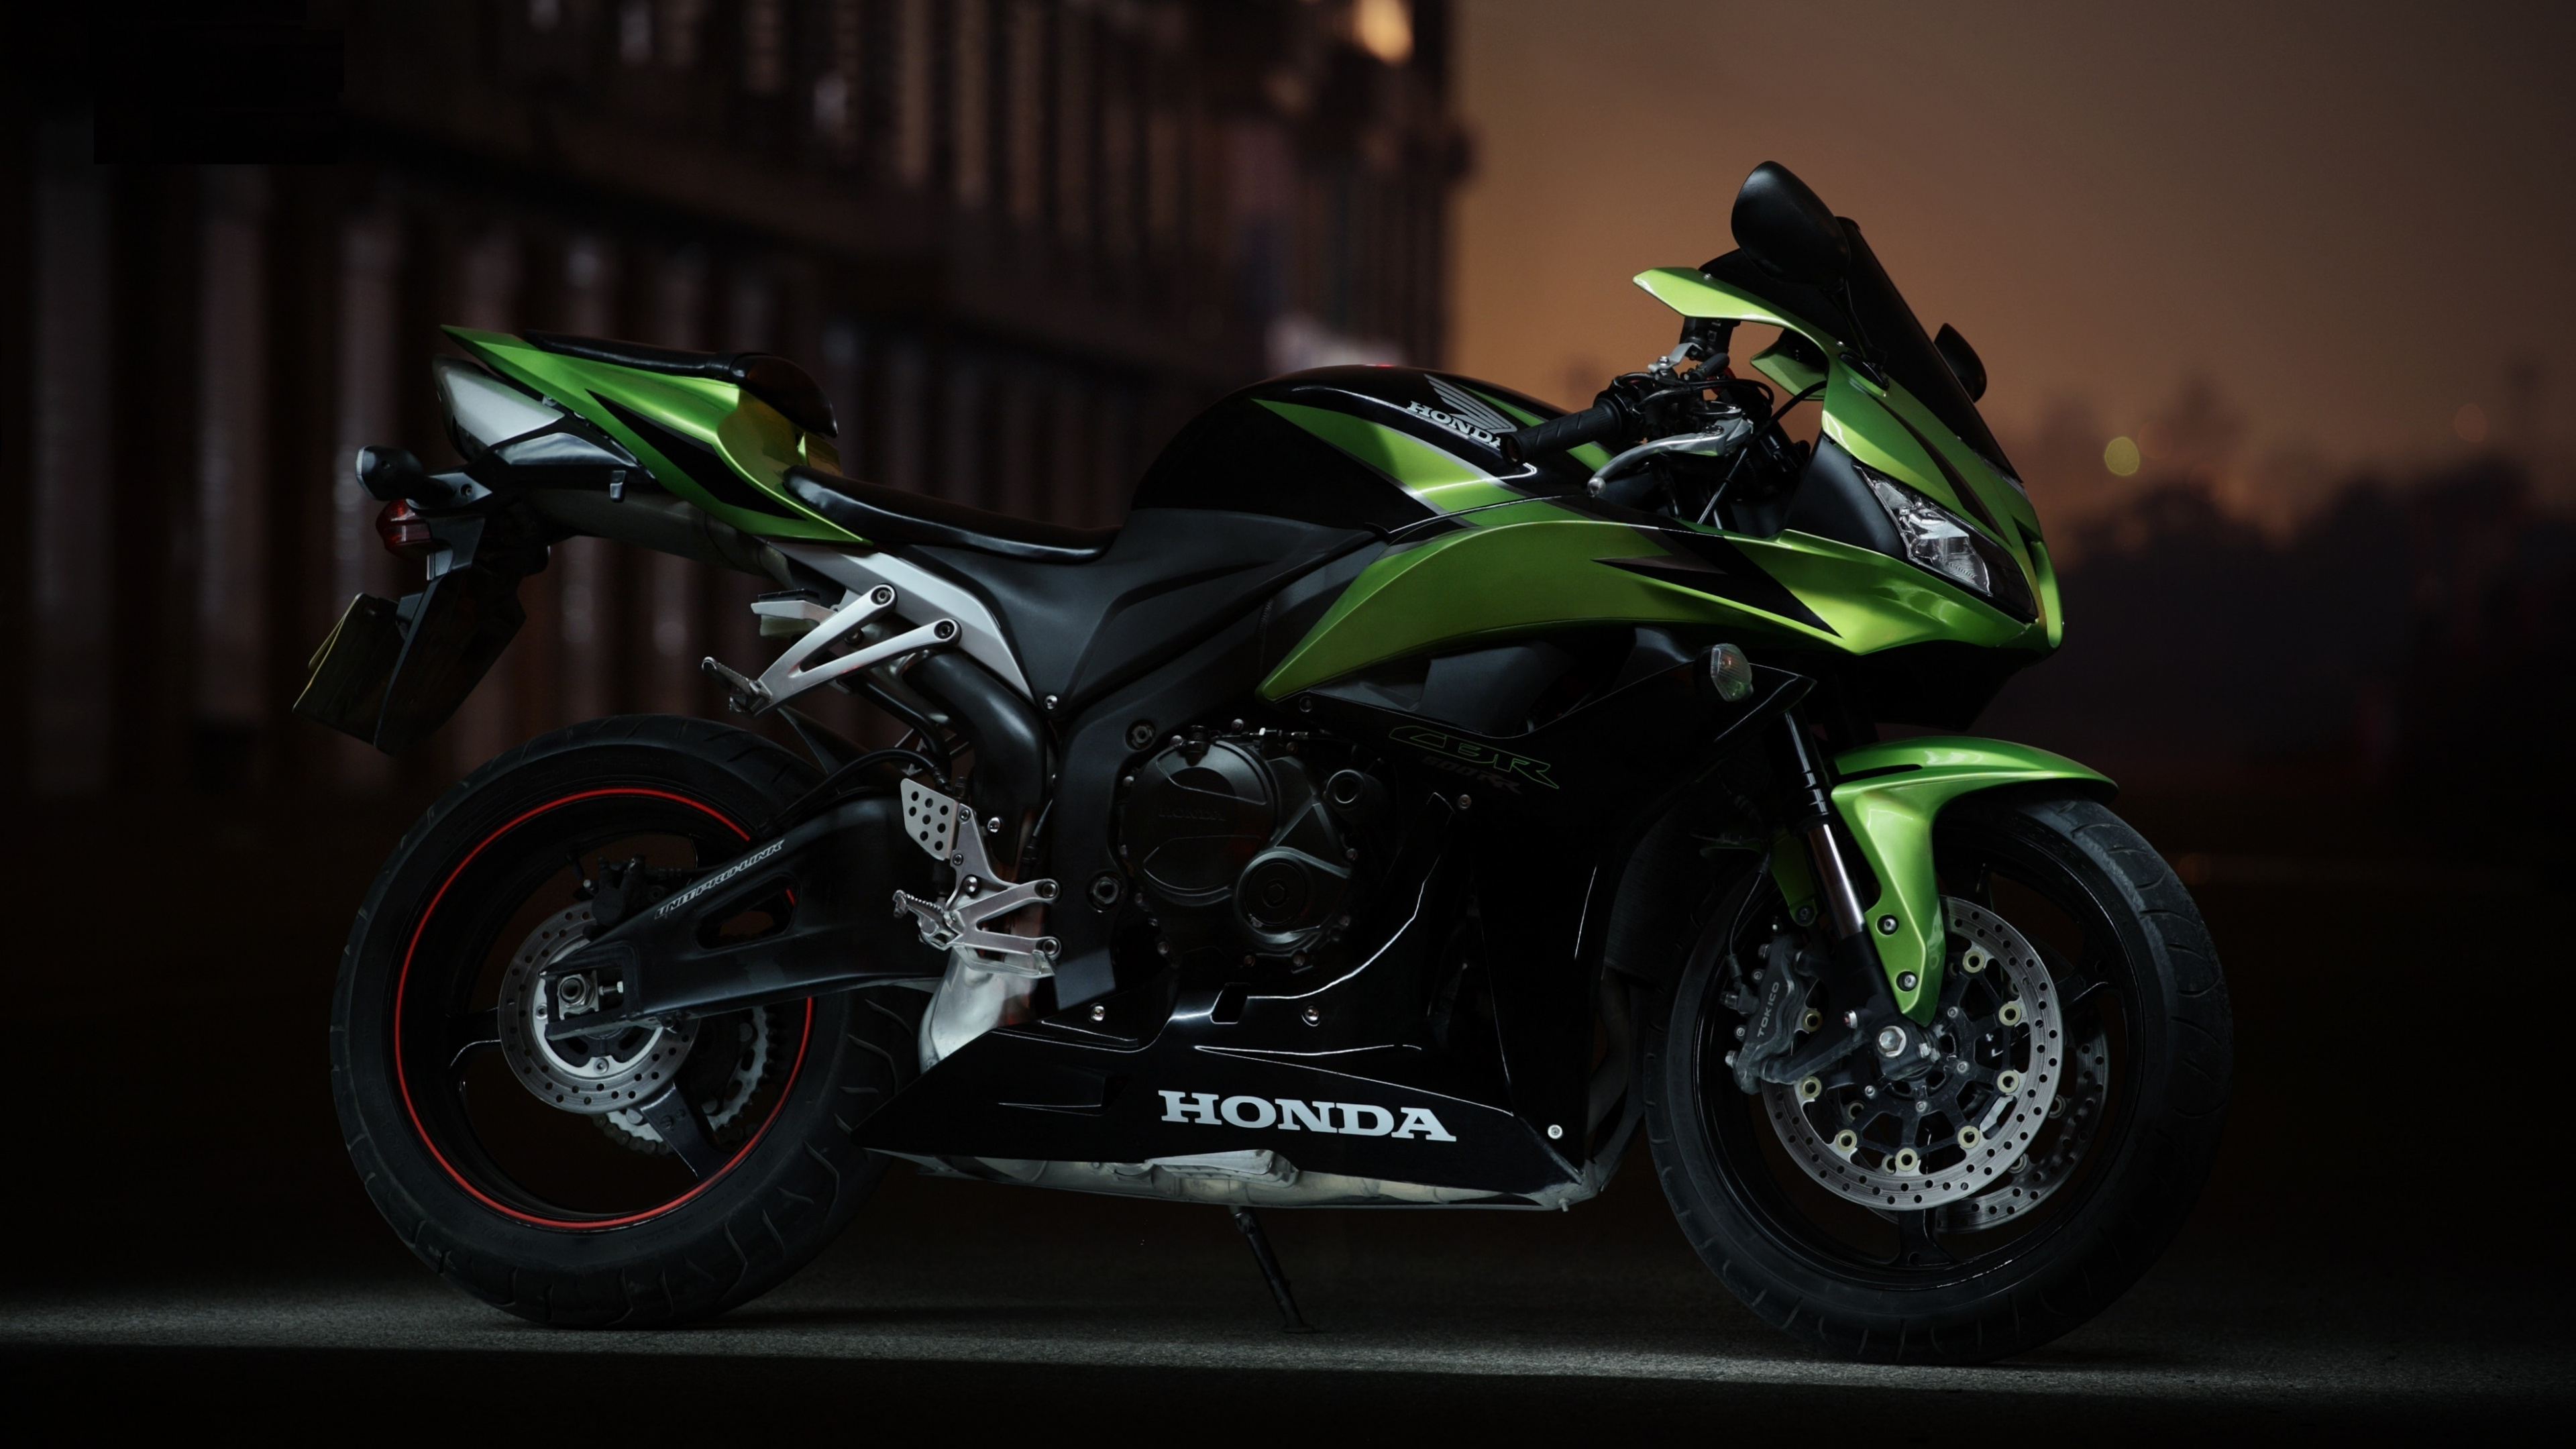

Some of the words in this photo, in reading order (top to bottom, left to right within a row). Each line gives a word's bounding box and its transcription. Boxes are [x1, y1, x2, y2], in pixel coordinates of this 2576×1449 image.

[1388, 725, 1560, 790] CBR
[654, 888, 698, 920] UNIT
[695, 839, 786, 897] PRO-LINK
[1757, 981, 1780, 1038] TOKICO
[1158, 1089, 1457, 1142] HONDA
